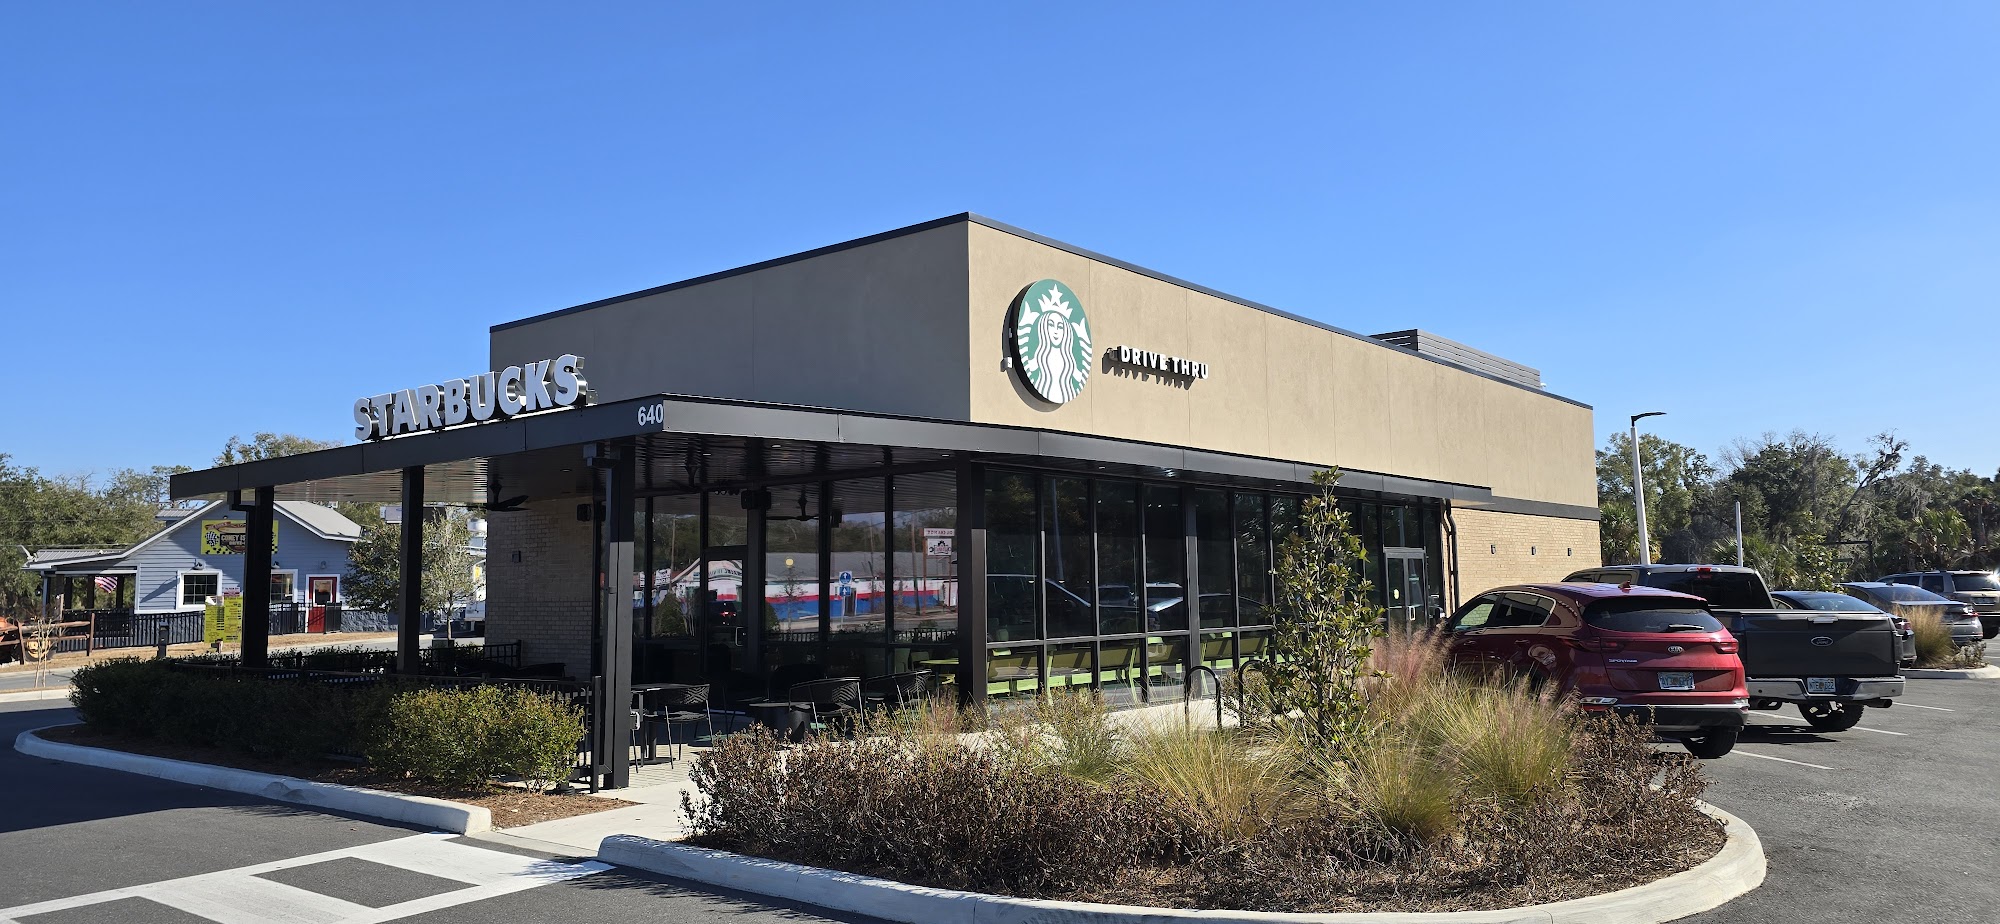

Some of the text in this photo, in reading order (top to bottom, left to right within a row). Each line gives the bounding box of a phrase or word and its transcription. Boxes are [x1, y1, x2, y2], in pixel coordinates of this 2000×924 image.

[1118, 345, 1208, 380] DRIVE THRU
[354, 354, 580, 441] STARBUCKS
[637, 403, 664, 427] 640
